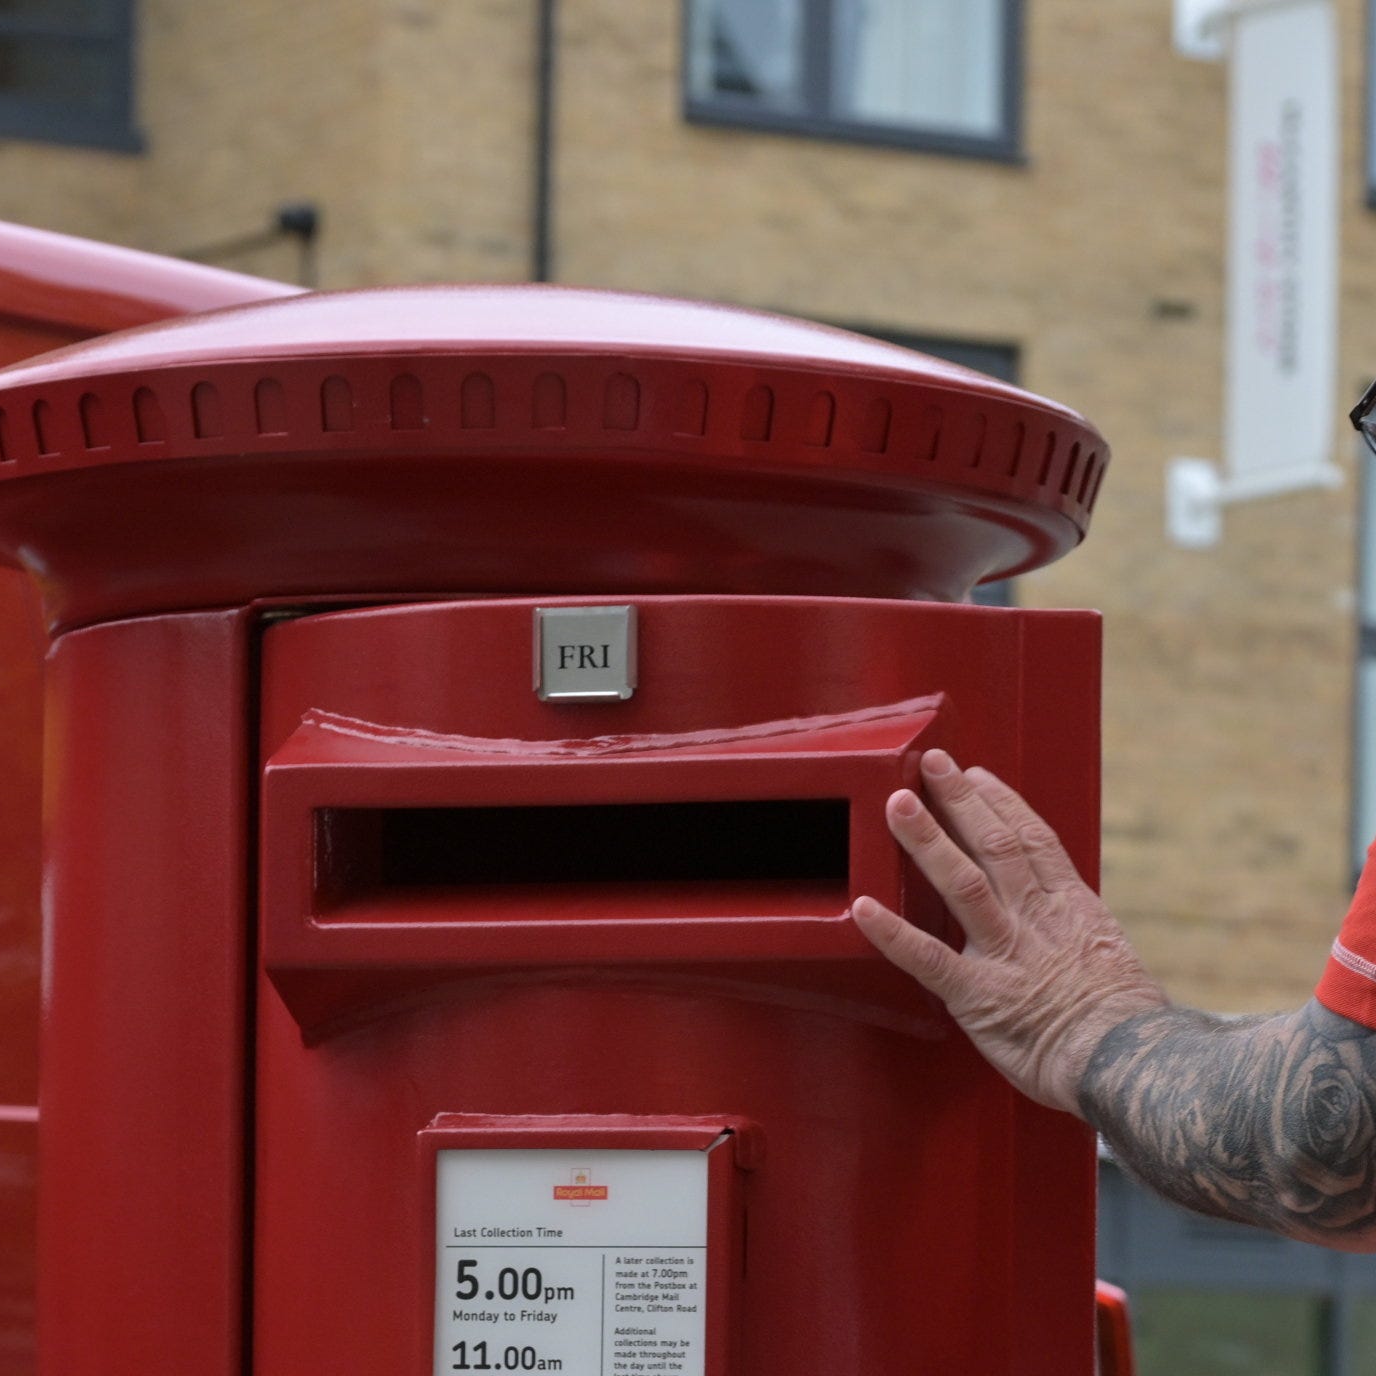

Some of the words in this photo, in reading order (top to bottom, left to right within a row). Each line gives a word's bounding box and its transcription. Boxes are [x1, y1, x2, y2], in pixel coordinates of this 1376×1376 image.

[558, 645, 610, 669] FRI
[556, 1187, 583, 1199] Royal
[454, 1228, 477, 1238] Last
[480, 1227, 533, 1238] Collection
[536, 1228, 563, 1238] Time
[624, 1257, 643, 1265] later
[646, 1257, 685, 1265] collection
[615, 1270, 638, 1278] made
[652, 1269, 688, 1279] 7.00pm
[455, 1259, 575, 1304] 5.00pm
[654, 1282, 686, 1290] Postbox
[689, 1282, 698, 1290] at
[615, 1293, 659, 1302] Cambridge
[662, 1293, 680, 1301] Mail
[452, 1310, 499, 1323] Monday
[504, 1311, 516, 1322] to
[520, 1310, 557, 1324] Friday
[614, 1328, 656, 1336] Additional
[614, 1339, 657, 1347] collections
[660, 1340, 677, 1348] may
[452, 1341, 563, 1371] 11.00am
[639, 1351, 686, 1360] throughout
[614, 1362, 628, 1370] the
[630, 1362, 645, 1371] day
[647, 1362, 666, 1370] until
[669, 1362, 682, 1370] the
